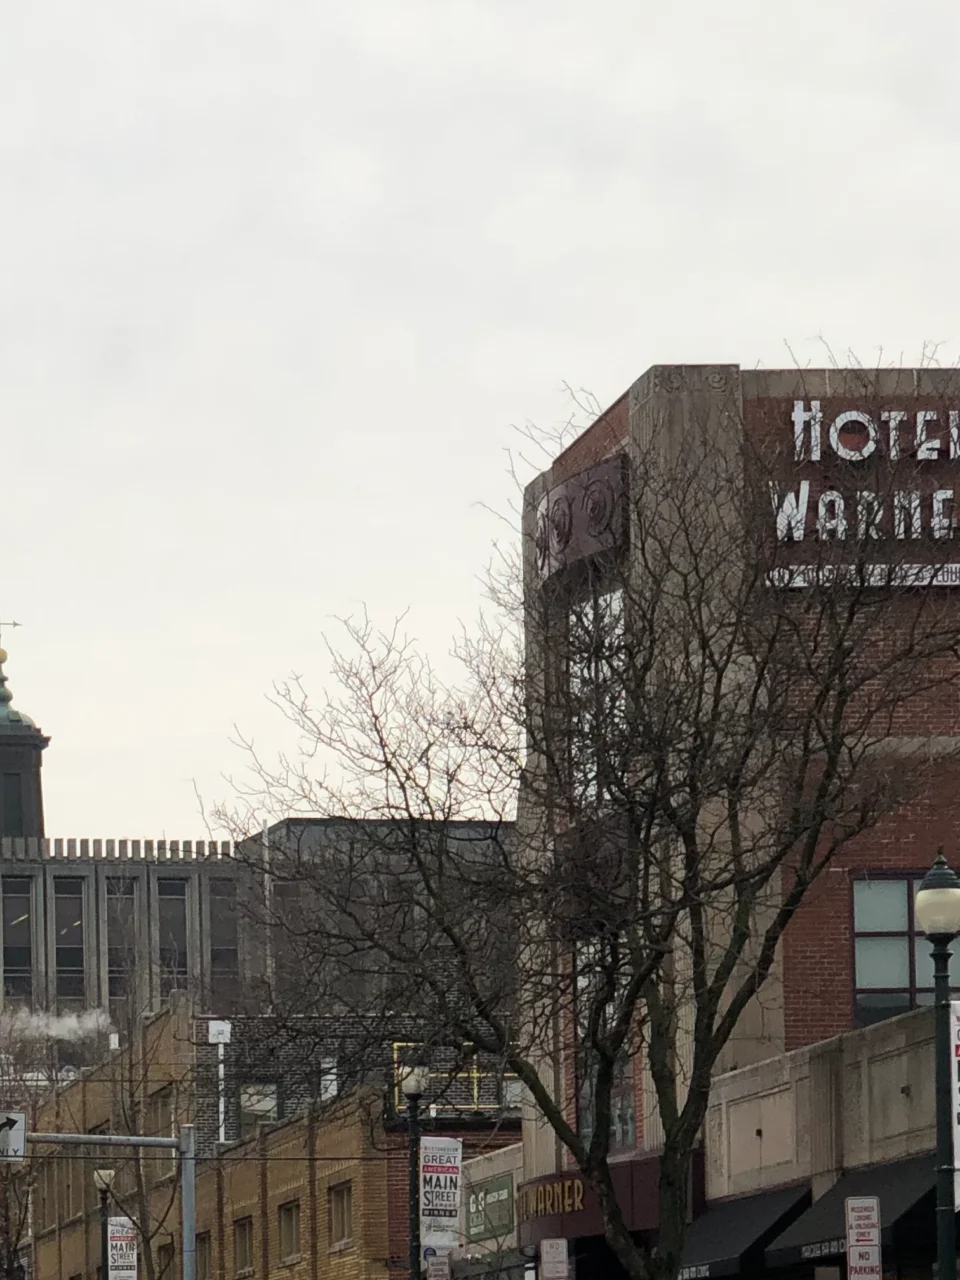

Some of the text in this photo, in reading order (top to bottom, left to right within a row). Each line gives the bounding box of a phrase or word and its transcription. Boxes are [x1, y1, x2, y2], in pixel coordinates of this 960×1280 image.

[423, 1154, 458, 1165] GREAT
[423, 1175, 458, 1190] MAIN
[423, 1191, 457, 1207] STREET
[530, 1179, 584, 1217] WARNER
[111, 1243, 135, 1253] MAIN
[858, 1251, 870, 1261] NO
[849, 1265, 880, 1275] PARKING
